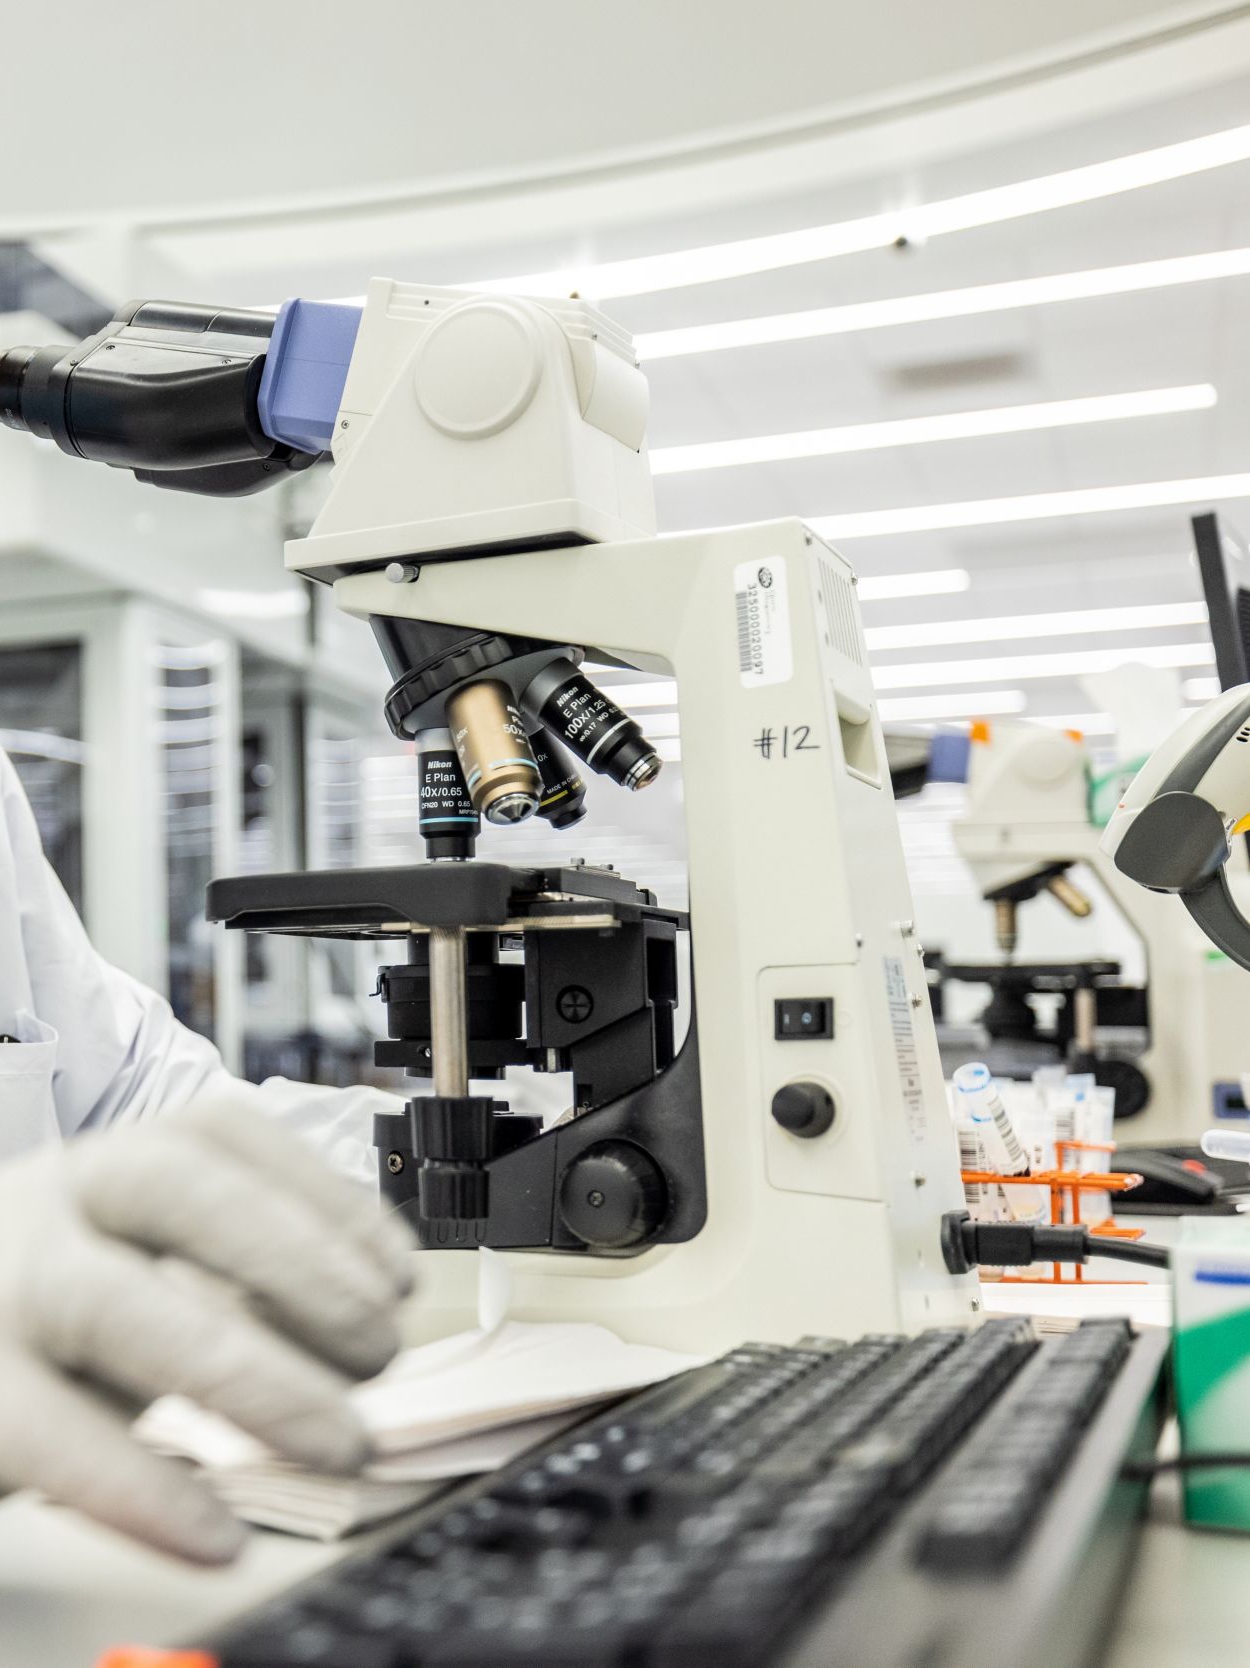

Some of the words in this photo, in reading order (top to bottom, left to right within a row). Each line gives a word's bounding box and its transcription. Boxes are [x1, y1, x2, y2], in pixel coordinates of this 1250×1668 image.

[556, 686, 579, 707] Nikon
[562, 708, 573, 719] E
[570, 693, 592, 710] Plan
[753, 726, 821, 760] #12
[427, 761, 452, 770] Nikon
[425, 773, 432, 783] E
[433, 773, 456, 782] Plan
[441, 800, 455, 808] WD
